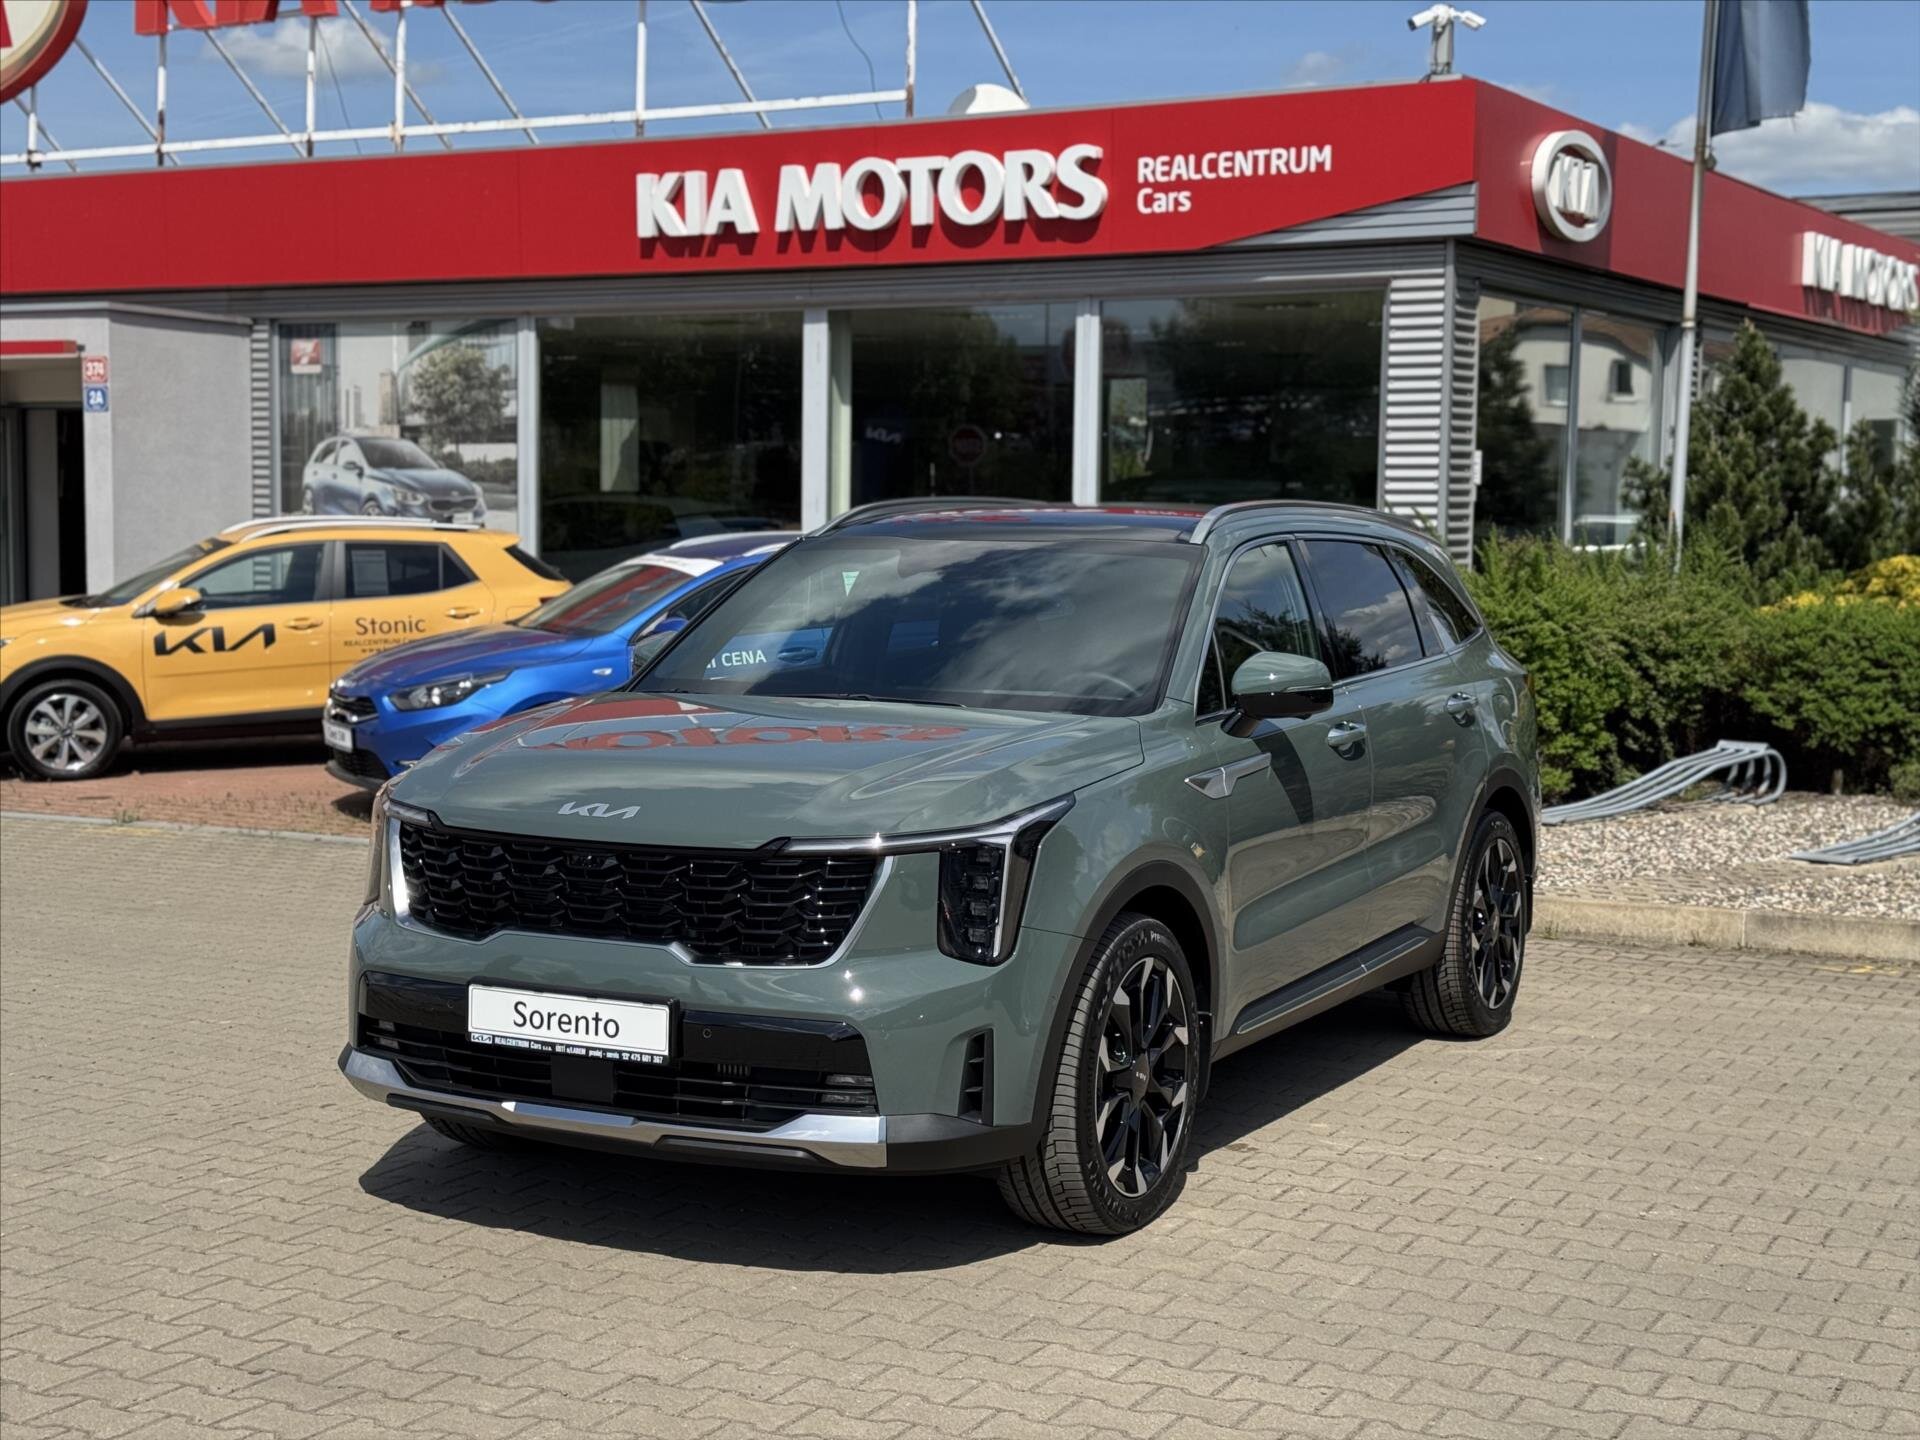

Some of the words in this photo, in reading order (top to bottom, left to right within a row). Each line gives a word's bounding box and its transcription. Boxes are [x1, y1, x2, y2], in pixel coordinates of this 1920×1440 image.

[1137, 144, 1332, 184] REALCENTRUM
[636, 168, 759, 238] KIA
[775, 144, 1108, 232] MOTORS
[1137, 188, 1192, 214] Cars
[89, 390, 104, 405] 2A
[355, 614, 426, 636] Stonic
[153, 623, 276, 656] KIA
[721, 650, 767, 667] CENA
[513, 1001, 620, 1038] Sorento
[494, 1037, 530, 1049] REALCENTRUM
